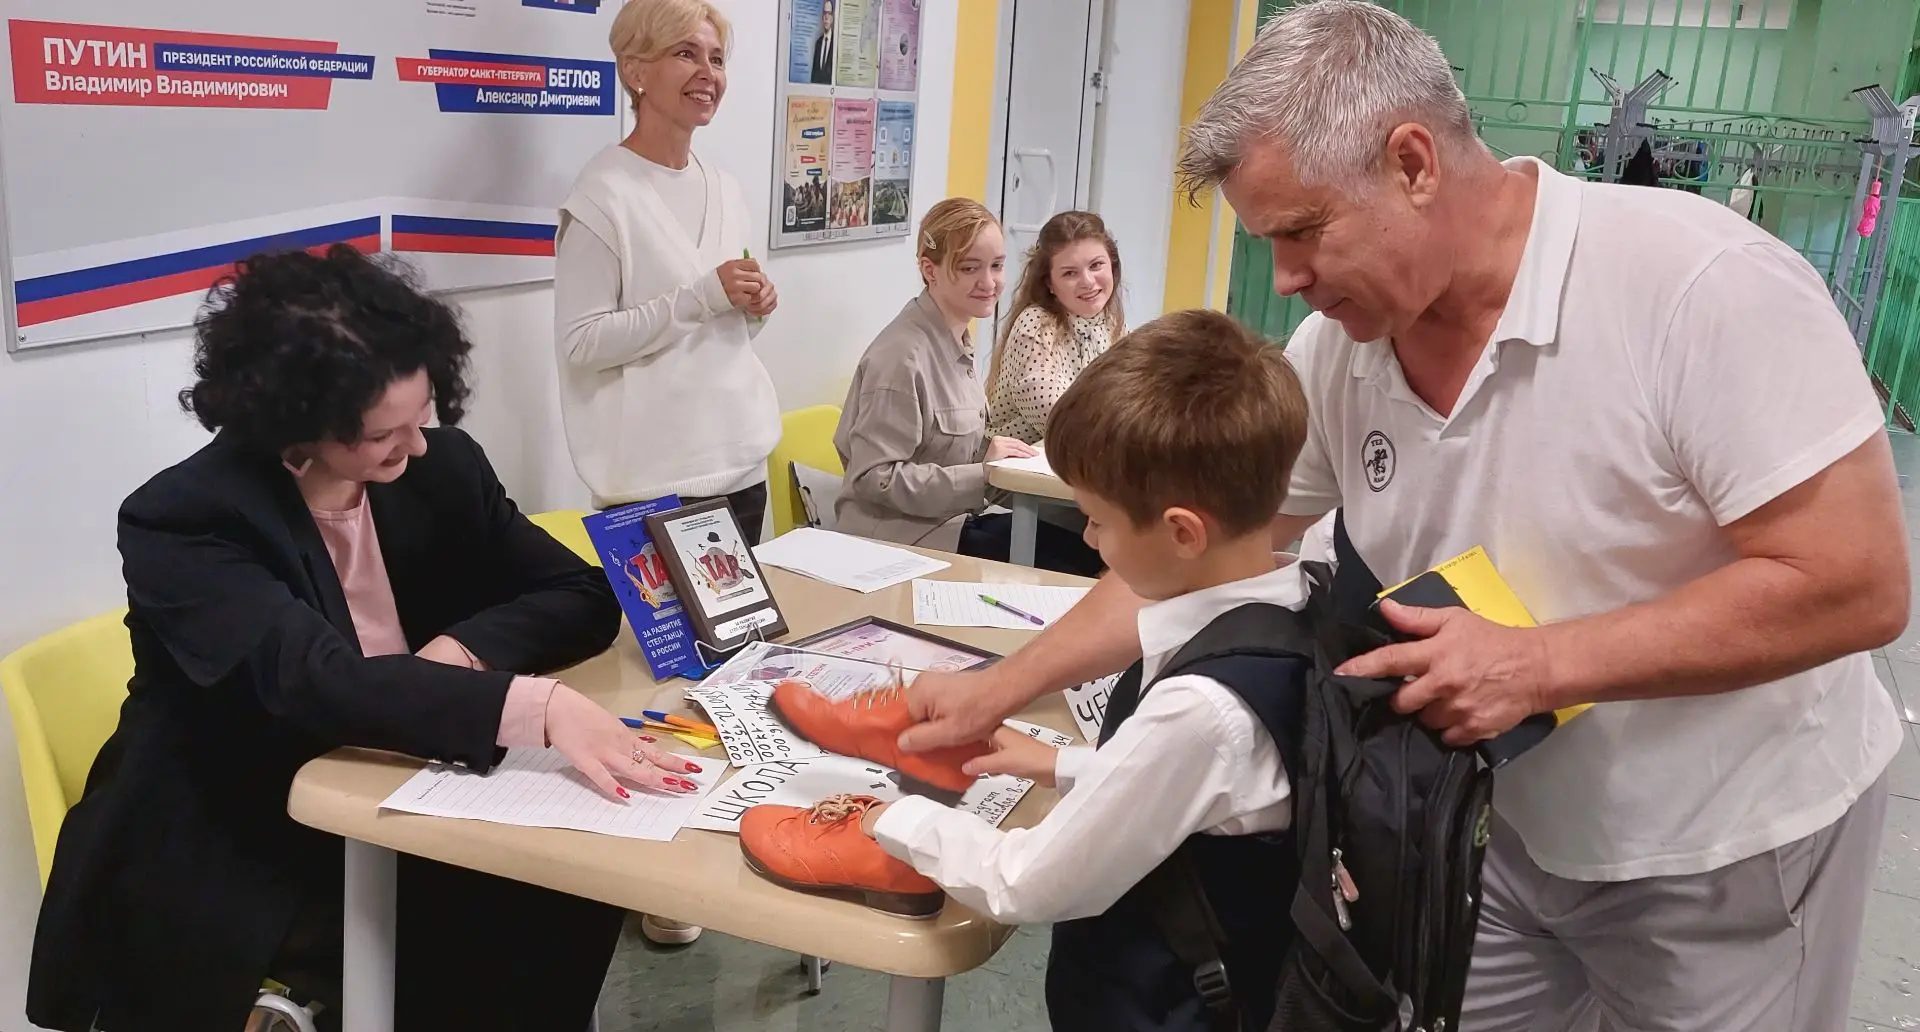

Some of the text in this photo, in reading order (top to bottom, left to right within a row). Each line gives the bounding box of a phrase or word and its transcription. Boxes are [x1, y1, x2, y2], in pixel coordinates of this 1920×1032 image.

[43, 37, 147, 69] ПУТИН
[163, 51, 368, 73] ПРЕЗИДЕНТ РОССИЙСКОЙ ФЕДЕРАЦИИ
[417, 65, 542, 82] ГУБЕРНАТОР САНКТ-ПЕТЕРБУРГА
[549, 68, 601, 89] БЕГЛОВ
[45, 70, 288, 100] Владимир Владимирович
[476, 88, 601, 110] Александр Дмитриевич
[631, 553, 669, 589] TA
[642, 618, 683, 638] ЗА РАЗВИТИЕ
[646, 629, 685, 648] СТЕП-ТАНЦА
[651, 641, 682, 658] В РОССИИ
[702, 760, 810, 821] ШКОЛА
